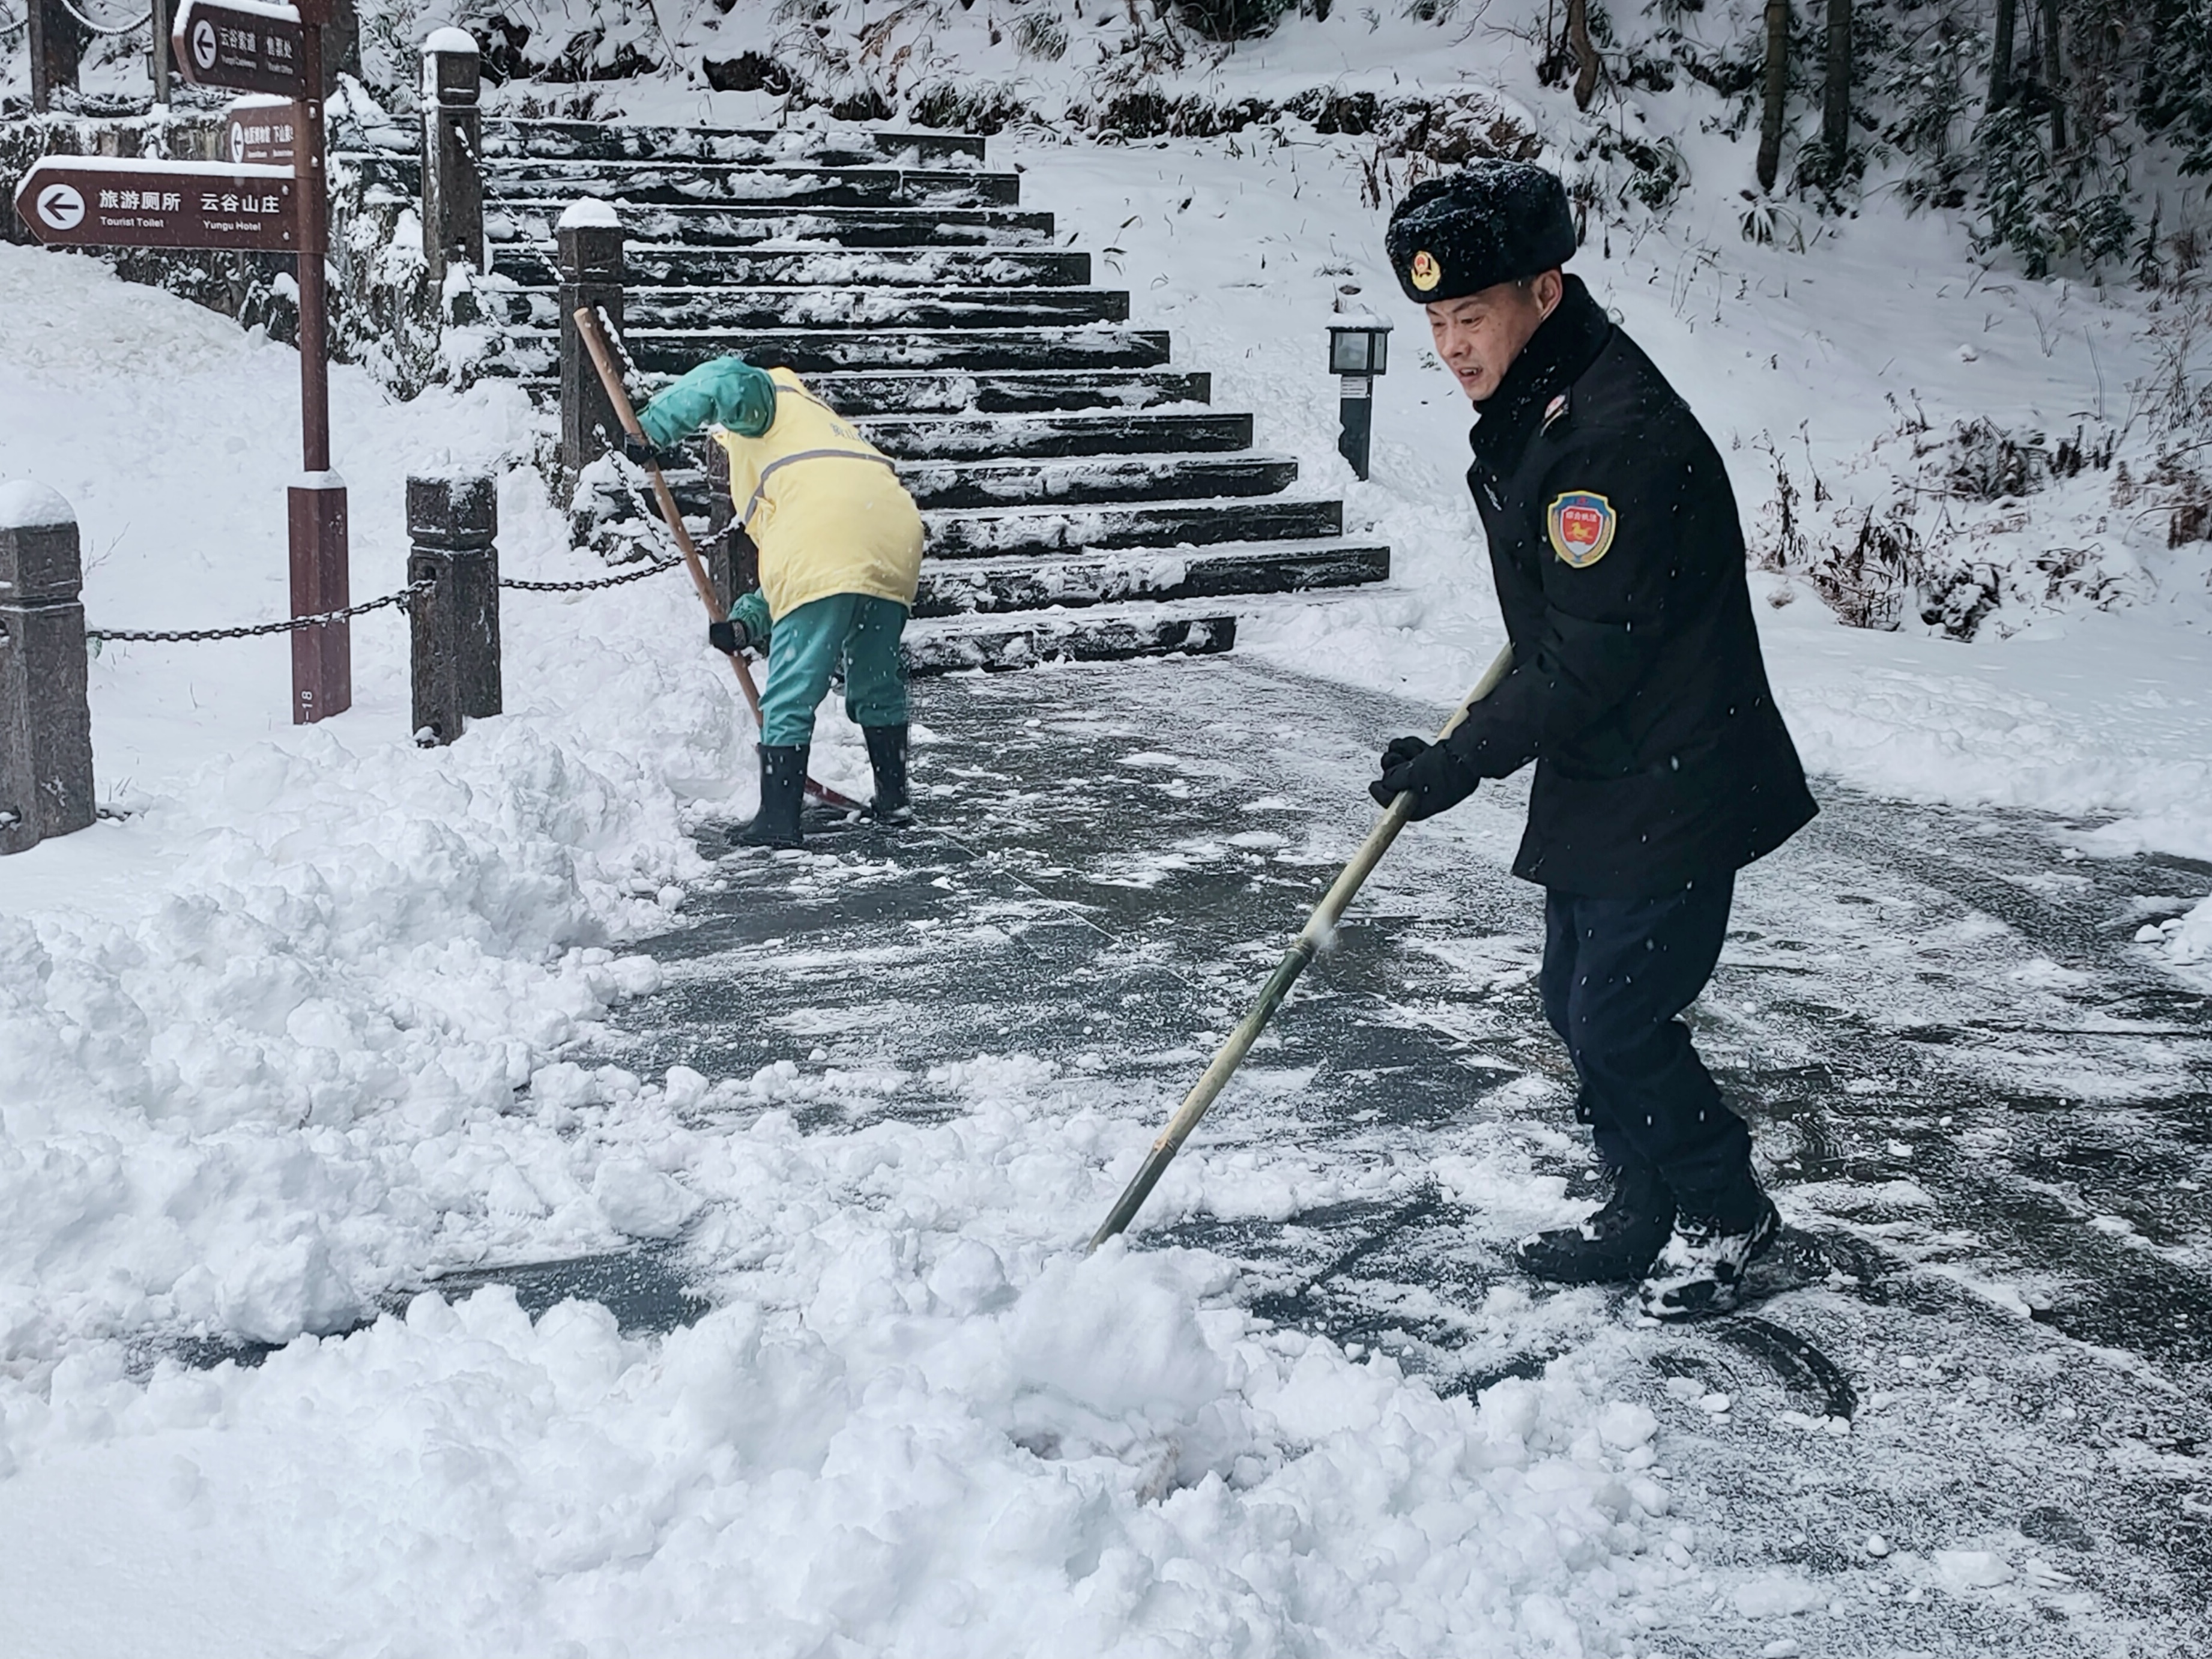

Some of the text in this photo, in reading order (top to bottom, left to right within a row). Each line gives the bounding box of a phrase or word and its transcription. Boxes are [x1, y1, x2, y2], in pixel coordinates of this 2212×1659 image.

[220, 26, 293, 59] 云谷索道 售票处
[99, 189, 280, 213] 旅游厕所 云谷山庄
[100, 216, 261, 231] Tourist Toilet Yungu Hotel
